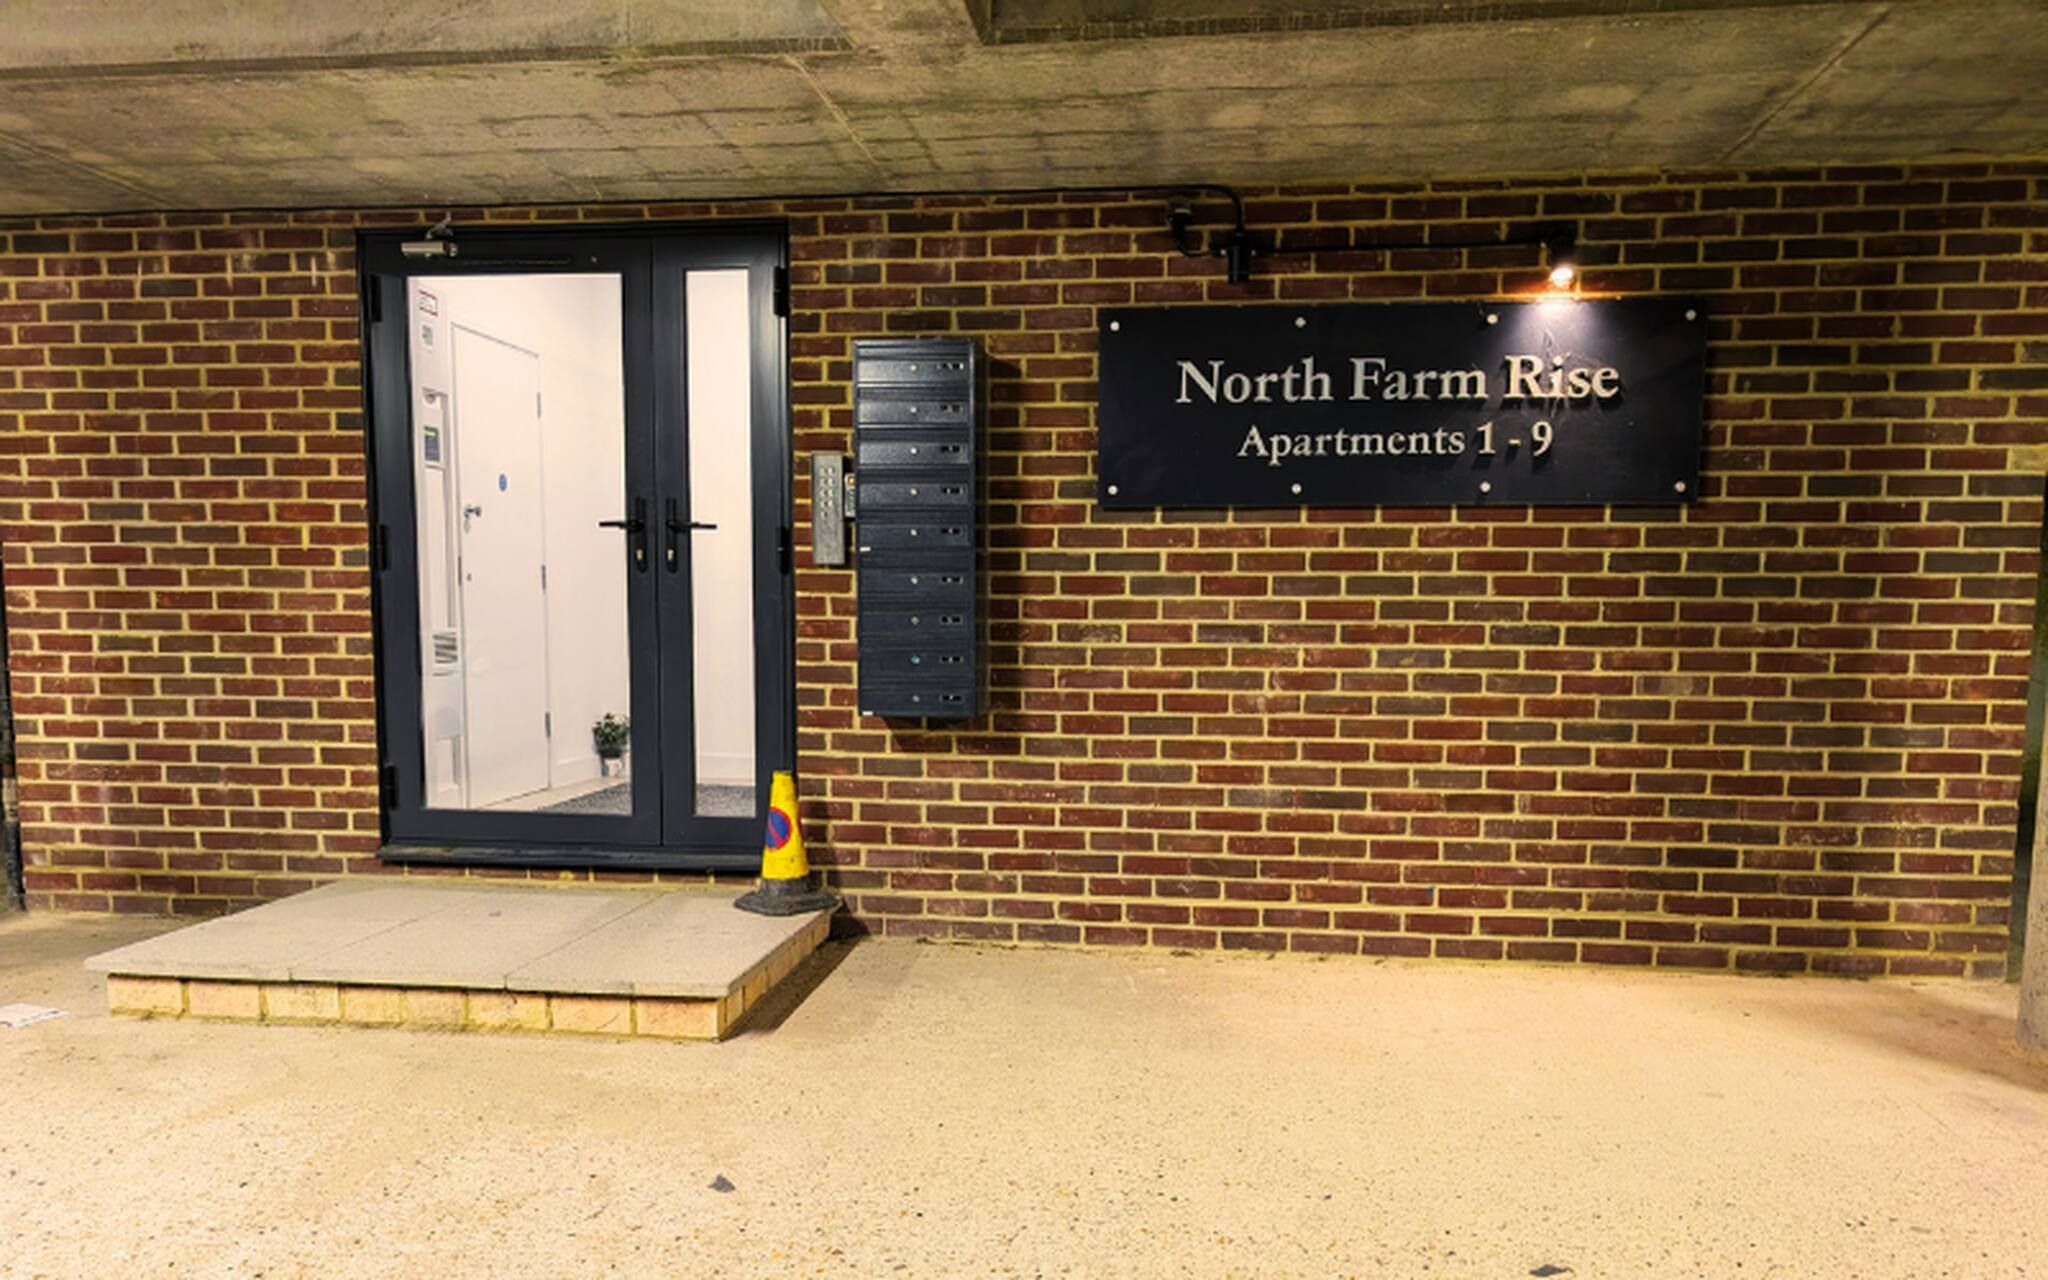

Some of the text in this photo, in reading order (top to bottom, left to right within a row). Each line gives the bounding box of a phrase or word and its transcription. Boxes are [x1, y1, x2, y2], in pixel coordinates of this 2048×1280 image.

[1176, 354, 1620, 403] North Farm Rise
[1237, 424, 1466, 466] Apartments
[1477, 421, 1497, 455] 1
[1531, 420, 1553, 456] 9
